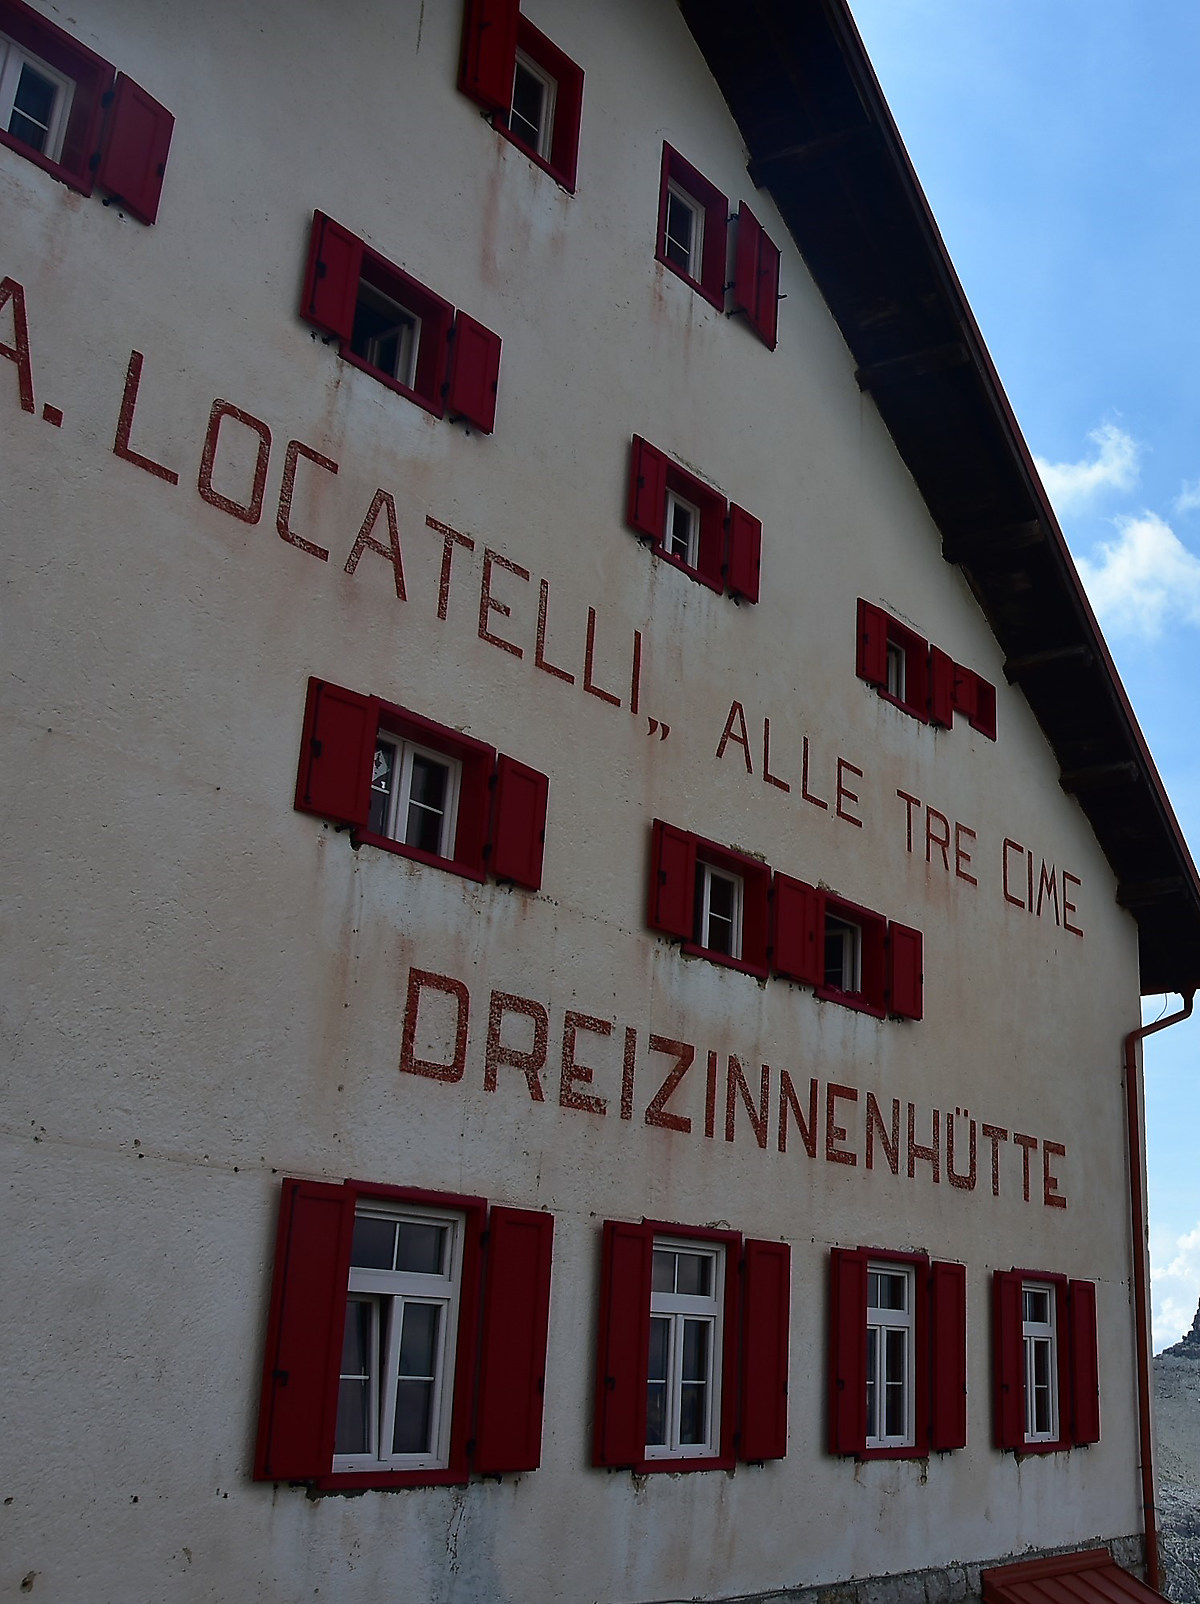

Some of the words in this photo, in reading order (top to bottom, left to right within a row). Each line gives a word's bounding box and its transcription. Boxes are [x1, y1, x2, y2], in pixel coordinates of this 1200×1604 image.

[715, 700, 863, 828] ALLE
[896, 789, 978, 886] TRE
[1002, 837, 1084, 937] CIME
[400, 966, 1067, 1208] DREIZINNENHÜTTE
